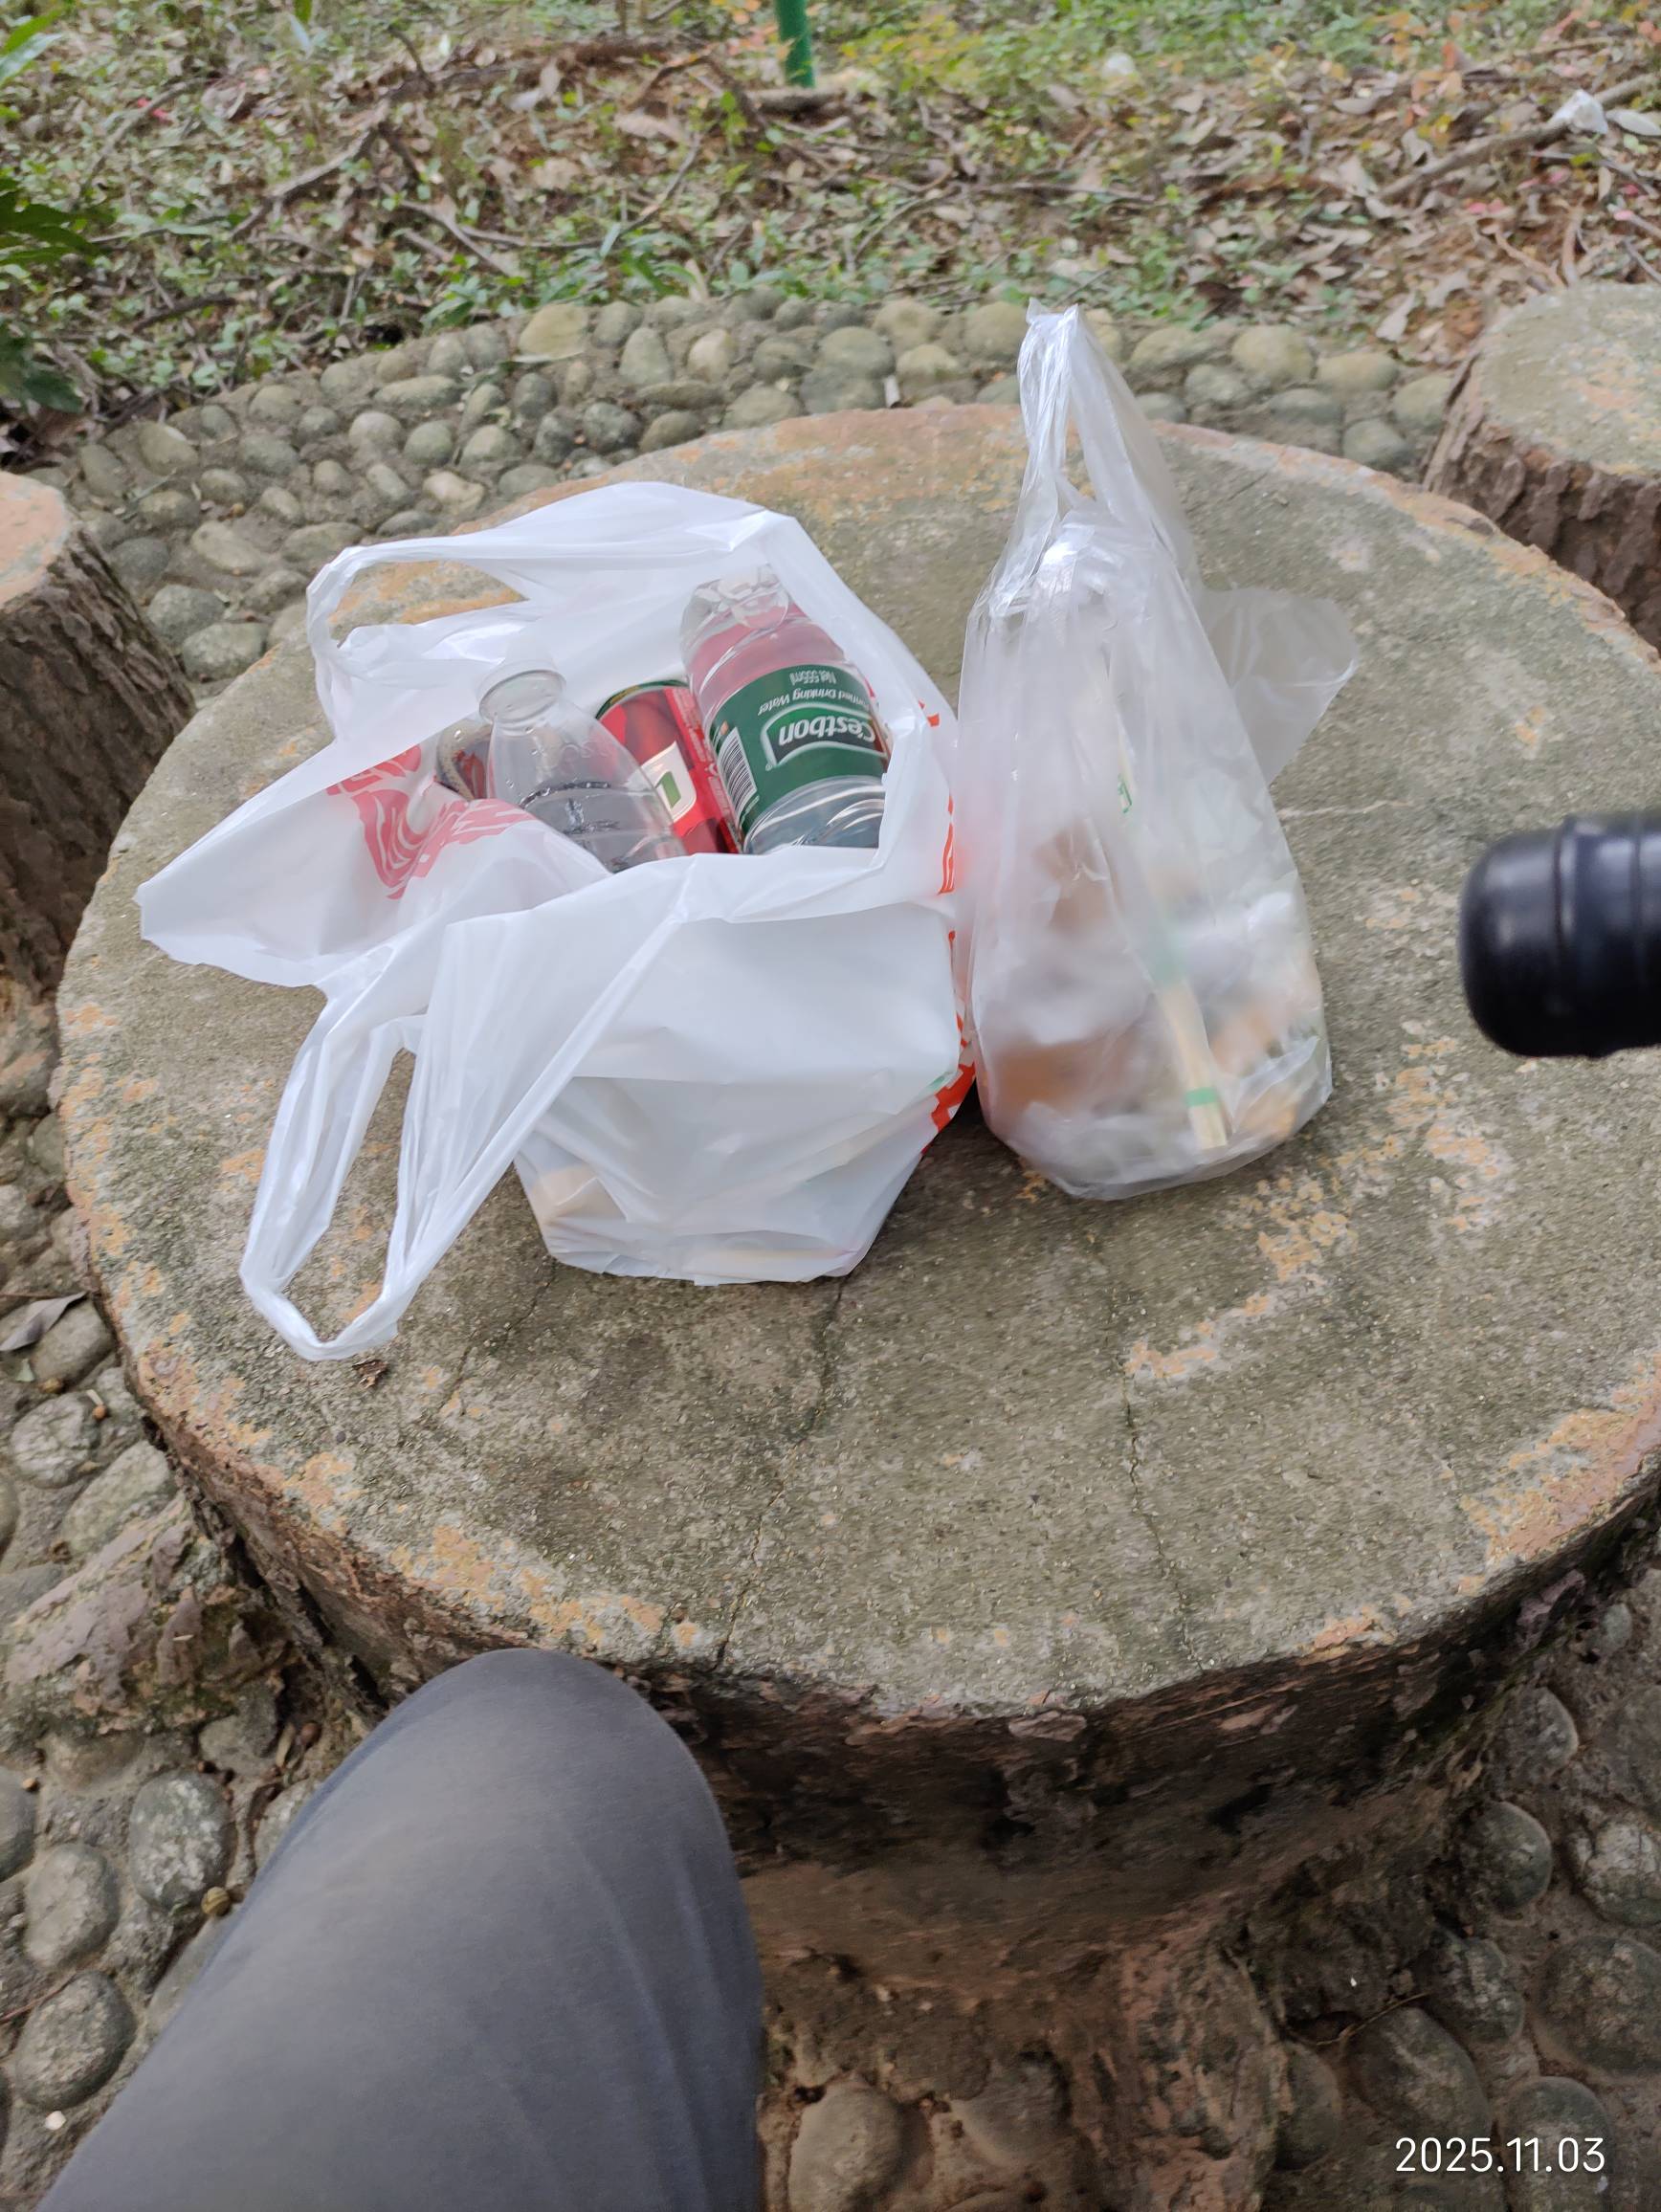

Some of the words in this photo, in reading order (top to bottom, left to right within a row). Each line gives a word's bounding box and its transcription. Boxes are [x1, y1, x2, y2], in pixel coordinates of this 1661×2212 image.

[758, 694, 790, 716] Water
[792, 688, 836, 701] Drinking
[779, 715, 875, 746] C'estbon
